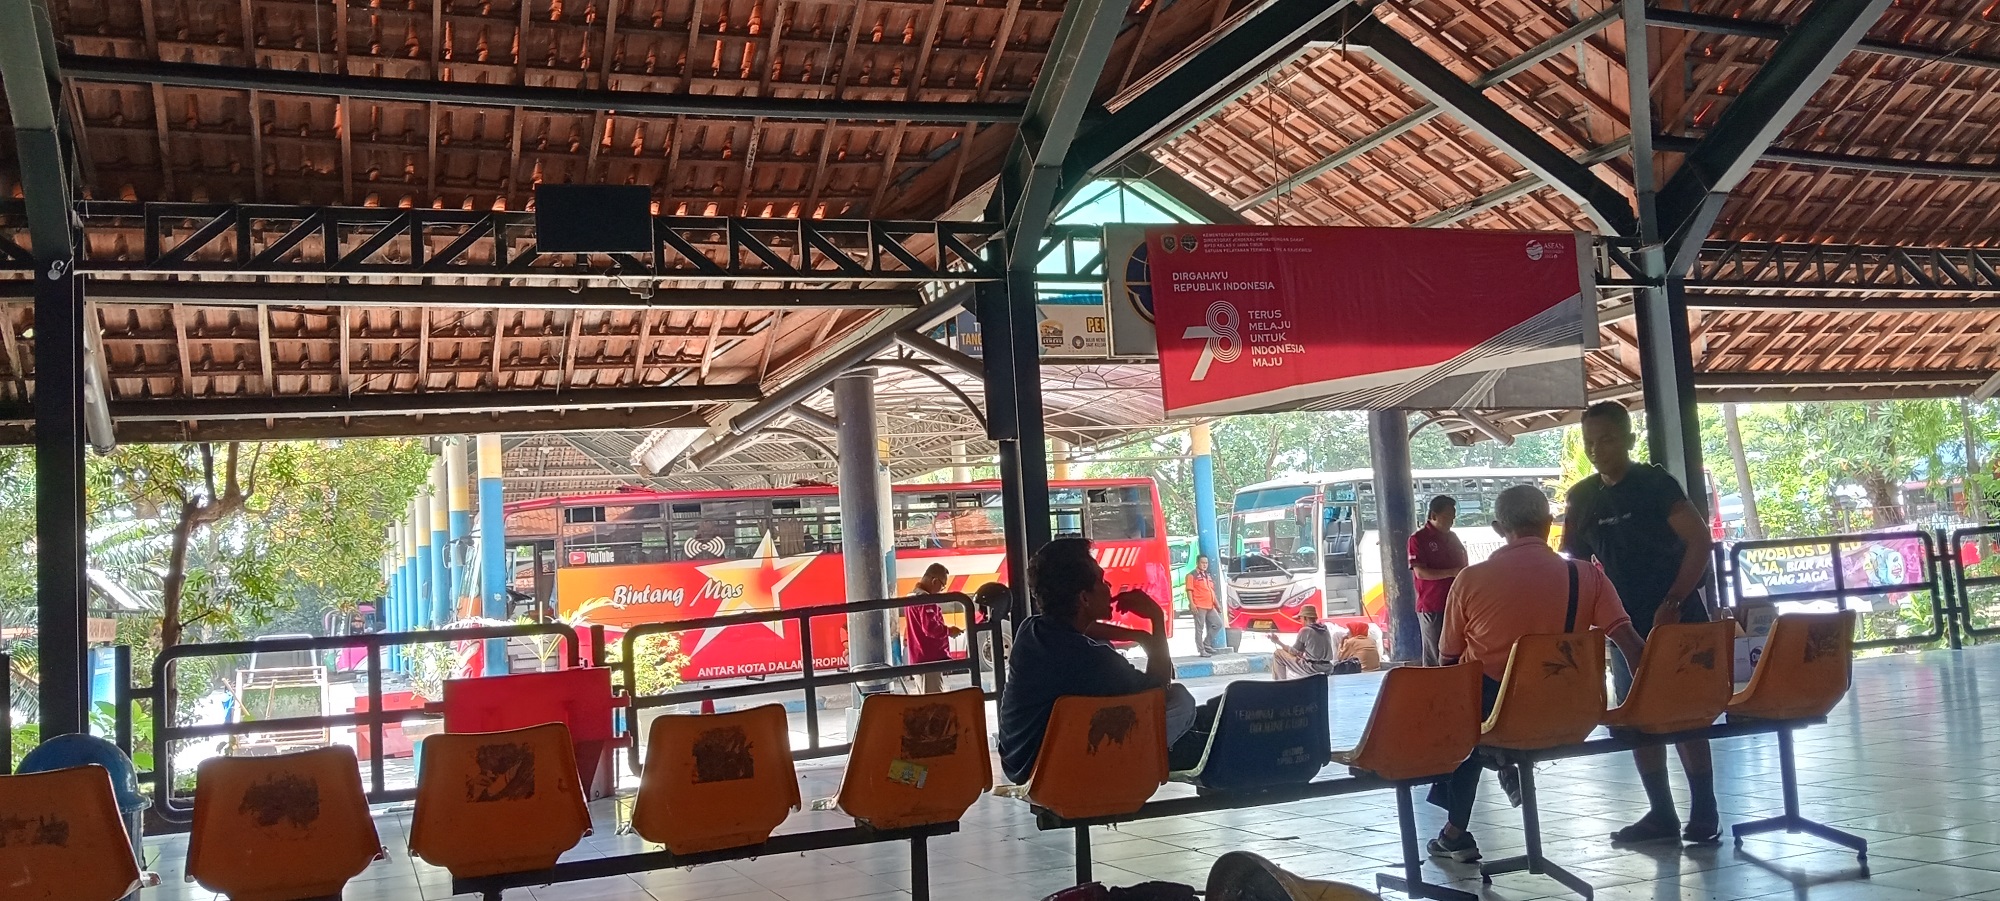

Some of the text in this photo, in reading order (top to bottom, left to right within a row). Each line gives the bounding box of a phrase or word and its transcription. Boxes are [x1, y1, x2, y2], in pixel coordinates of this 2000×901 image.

[1172, 271, 1228, 281] DIRGAHAYU
[1174, 281, 1275, 292] REPUBLIK INDONESIA
[1248, 309, 1282, 319] TERUS
[1249, 321, 1291, 331] MELAJU
[1182, 300, 1242, 381] 78
[1250, 332, 1287, 343] UNTUK
[1251, 344, 1305, 355] INDONESIA
[1252, 357, 1283, 367] MAJU
[586, 551, 615, 564] YouTube
[1746, 541, 1862, 563] NYOBLOS DLU
[1750, 561, 1784, 576] AJA,
[1761, 570, 1829, 587] YANG JAGA
[613, 577, 743, 607] Bintang Mas
[697, 666, 735, 677] ANTAR
[737, 663, 767, 674] KOTA
